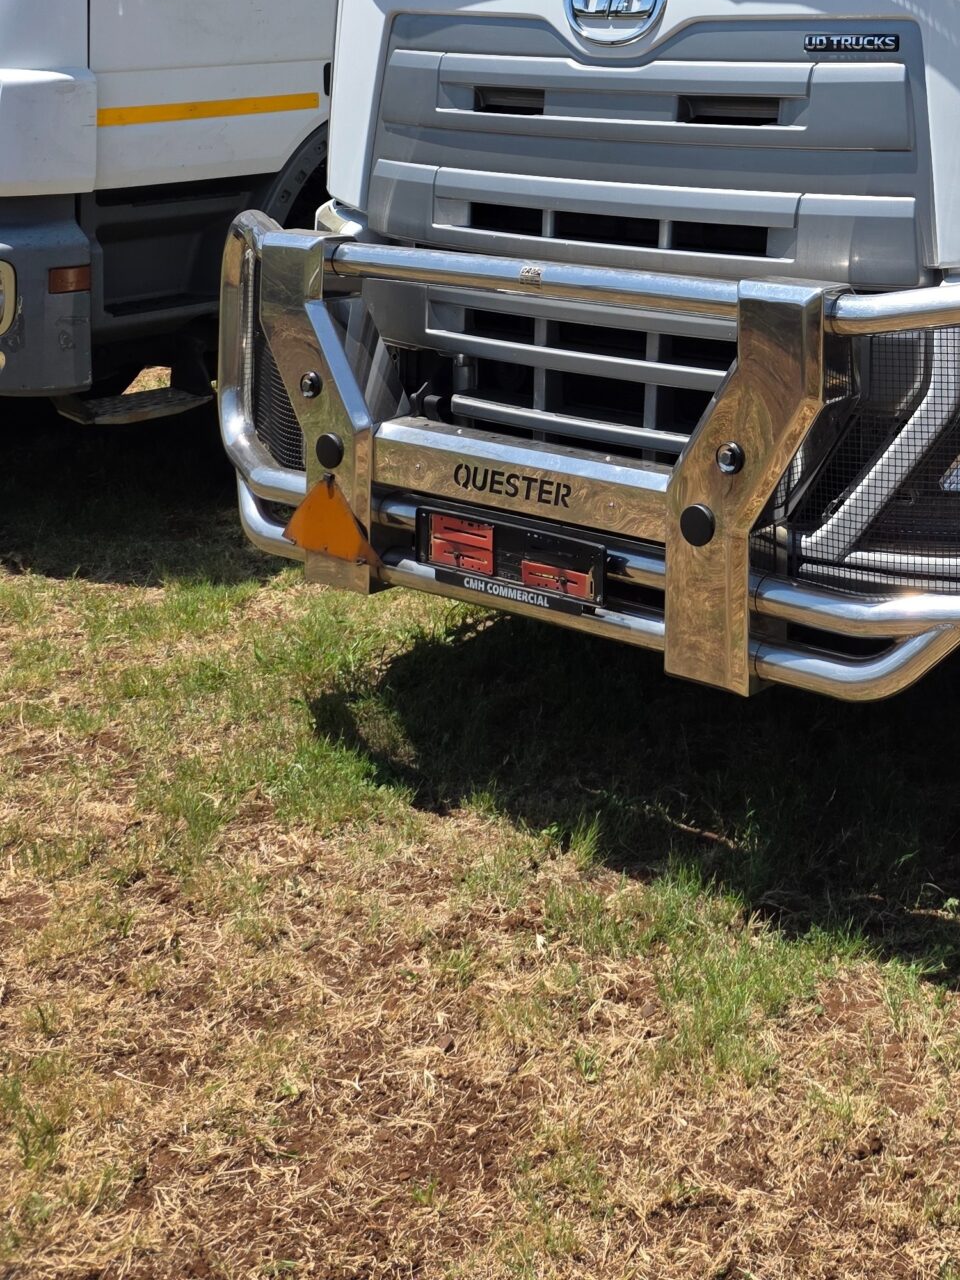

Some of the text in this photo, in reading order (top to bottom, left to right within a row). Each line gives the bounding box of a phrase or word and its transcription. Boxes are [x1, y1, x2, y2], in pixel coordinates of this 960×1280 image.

[804, 35, 896, 50] UD TRUCKS
[453, 463, 572, 508] QUESTER
[463, 577, 550, 608] CMH COMMERCIAL
